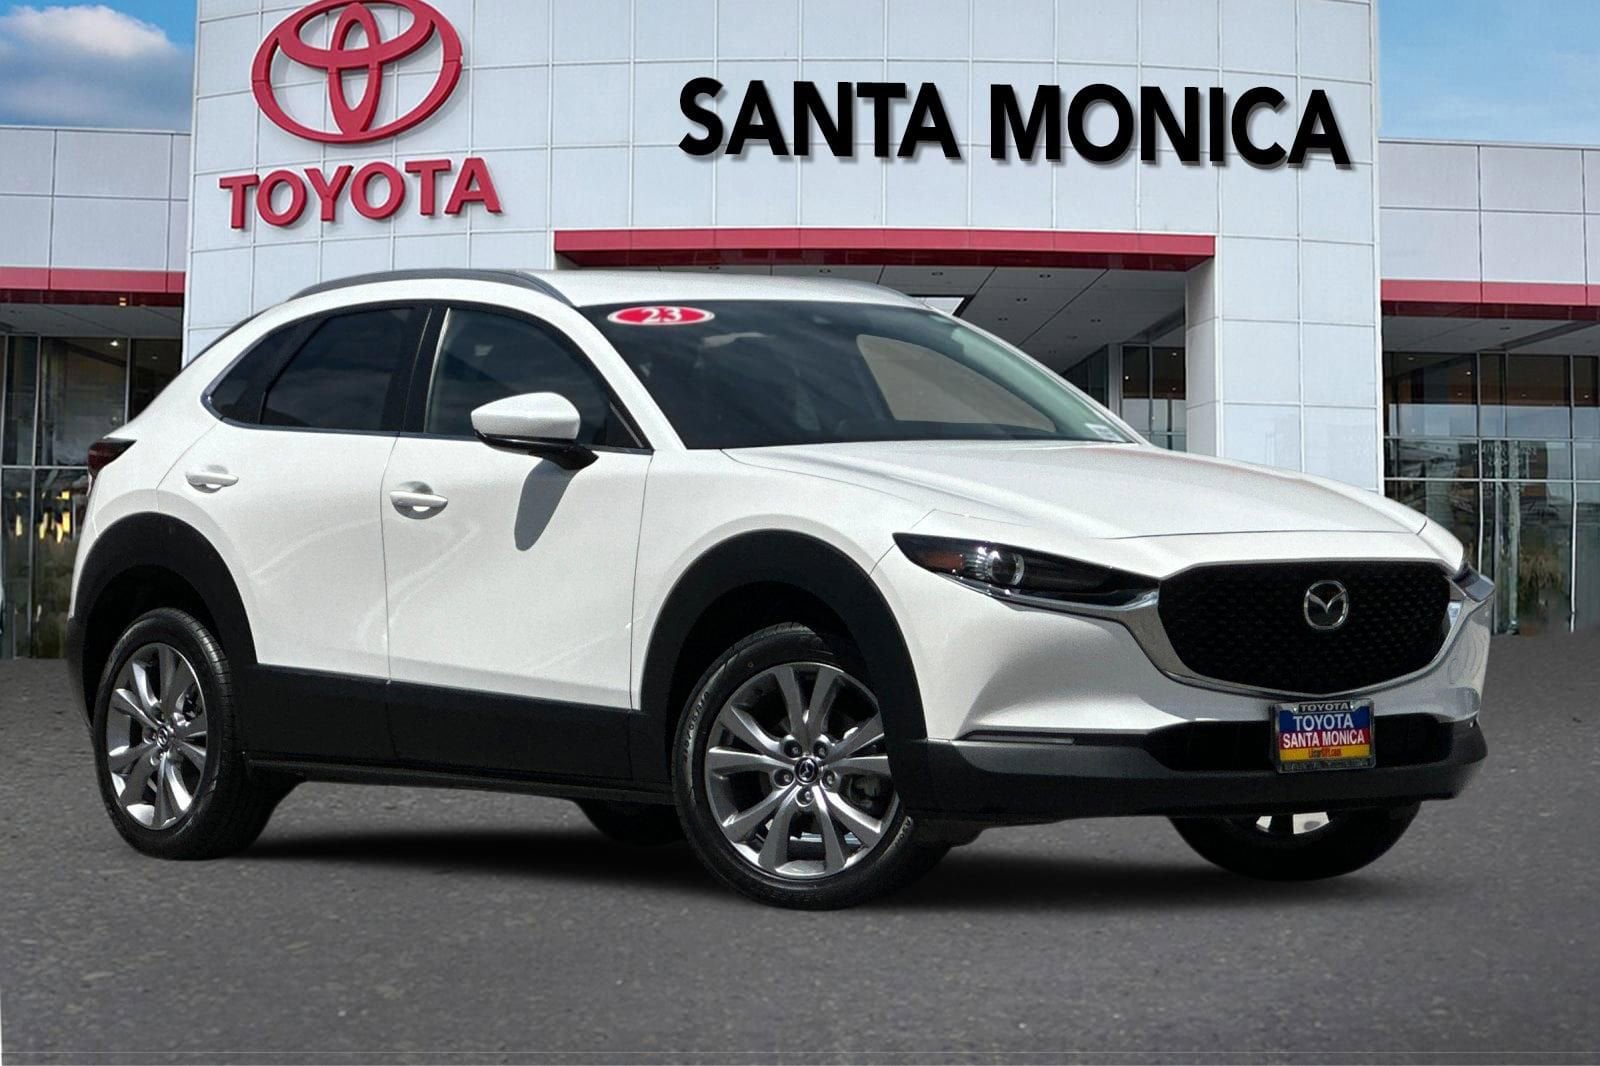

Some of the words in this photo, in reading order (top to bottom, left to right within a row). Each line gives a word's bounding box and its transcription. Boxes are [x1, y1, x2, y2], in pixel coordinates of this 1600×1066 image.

[678, 77, 961, 159] SANTA
[989, 83, 1350, 169] MONICA
[219, 157, 502, 230] TOYOTA
[641, 307, 682, 324] 23
[1301, 702, 1349, 711] TOYOTA
[1293, 713, 1354, 731] TOYOTA
[1283, 732, 1319, 748] SANTA
[1322, 729, 1365, 746] MONICA
